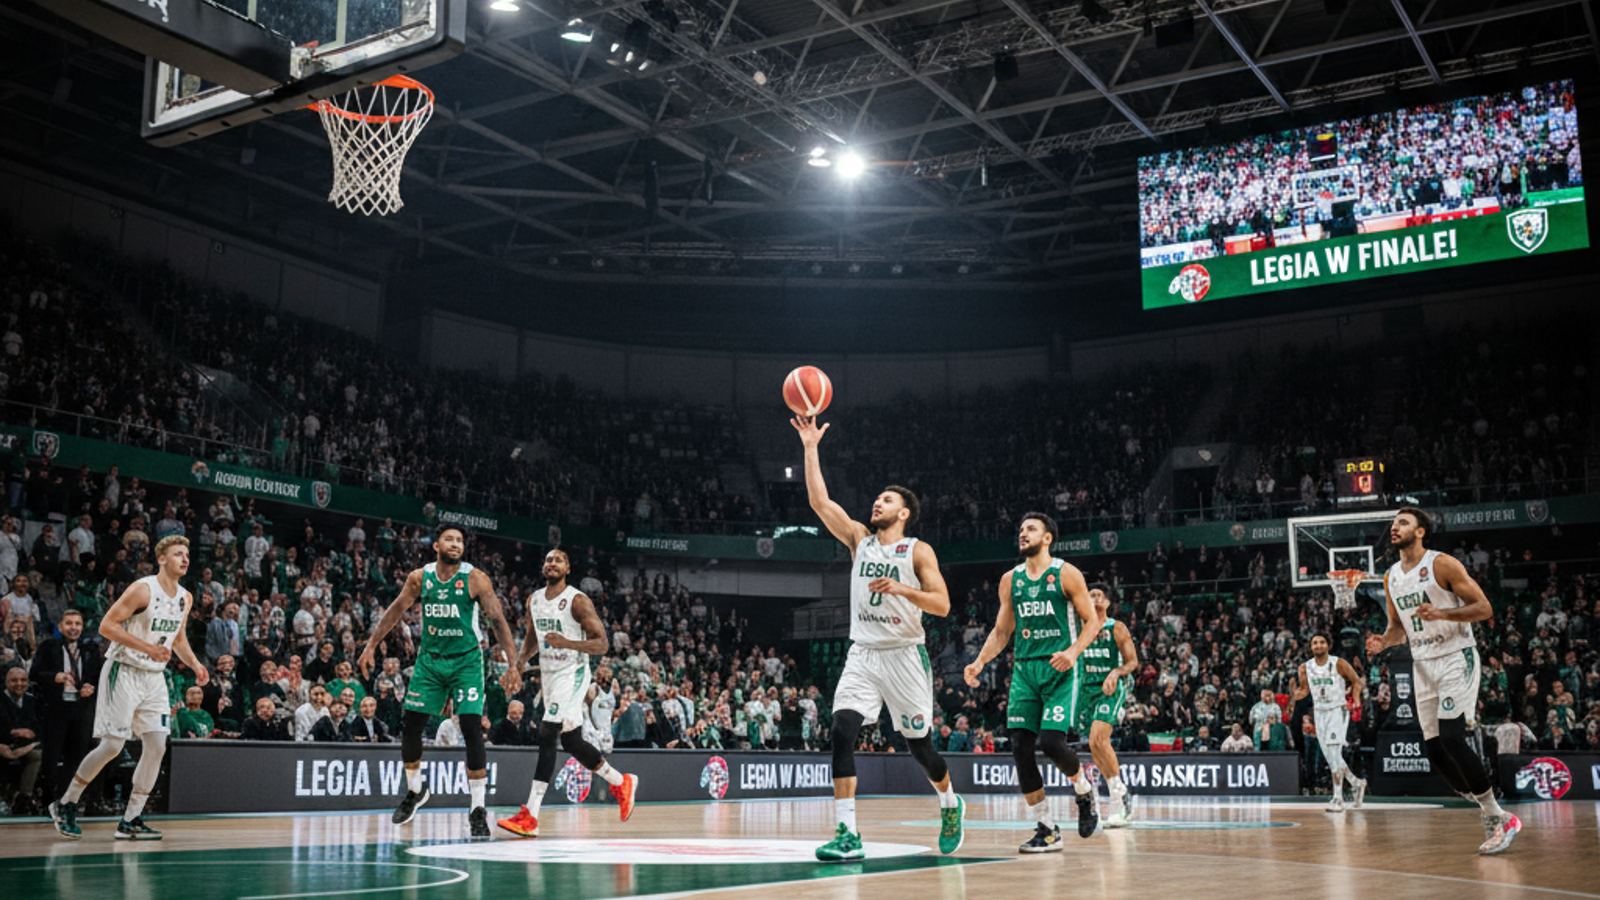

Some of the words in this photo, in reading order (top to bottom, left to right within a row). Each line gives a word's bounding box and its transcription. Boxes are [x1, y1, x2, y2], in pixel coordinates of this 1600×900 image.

[1250, 251, 1320, 286] LEGIA
[1325, 245, 1351, 275] W
[1358, 229, 1459, 271] FINALE!
[295, 759, 372, 797] LEGIA
[379, 760, 404, 796] W
